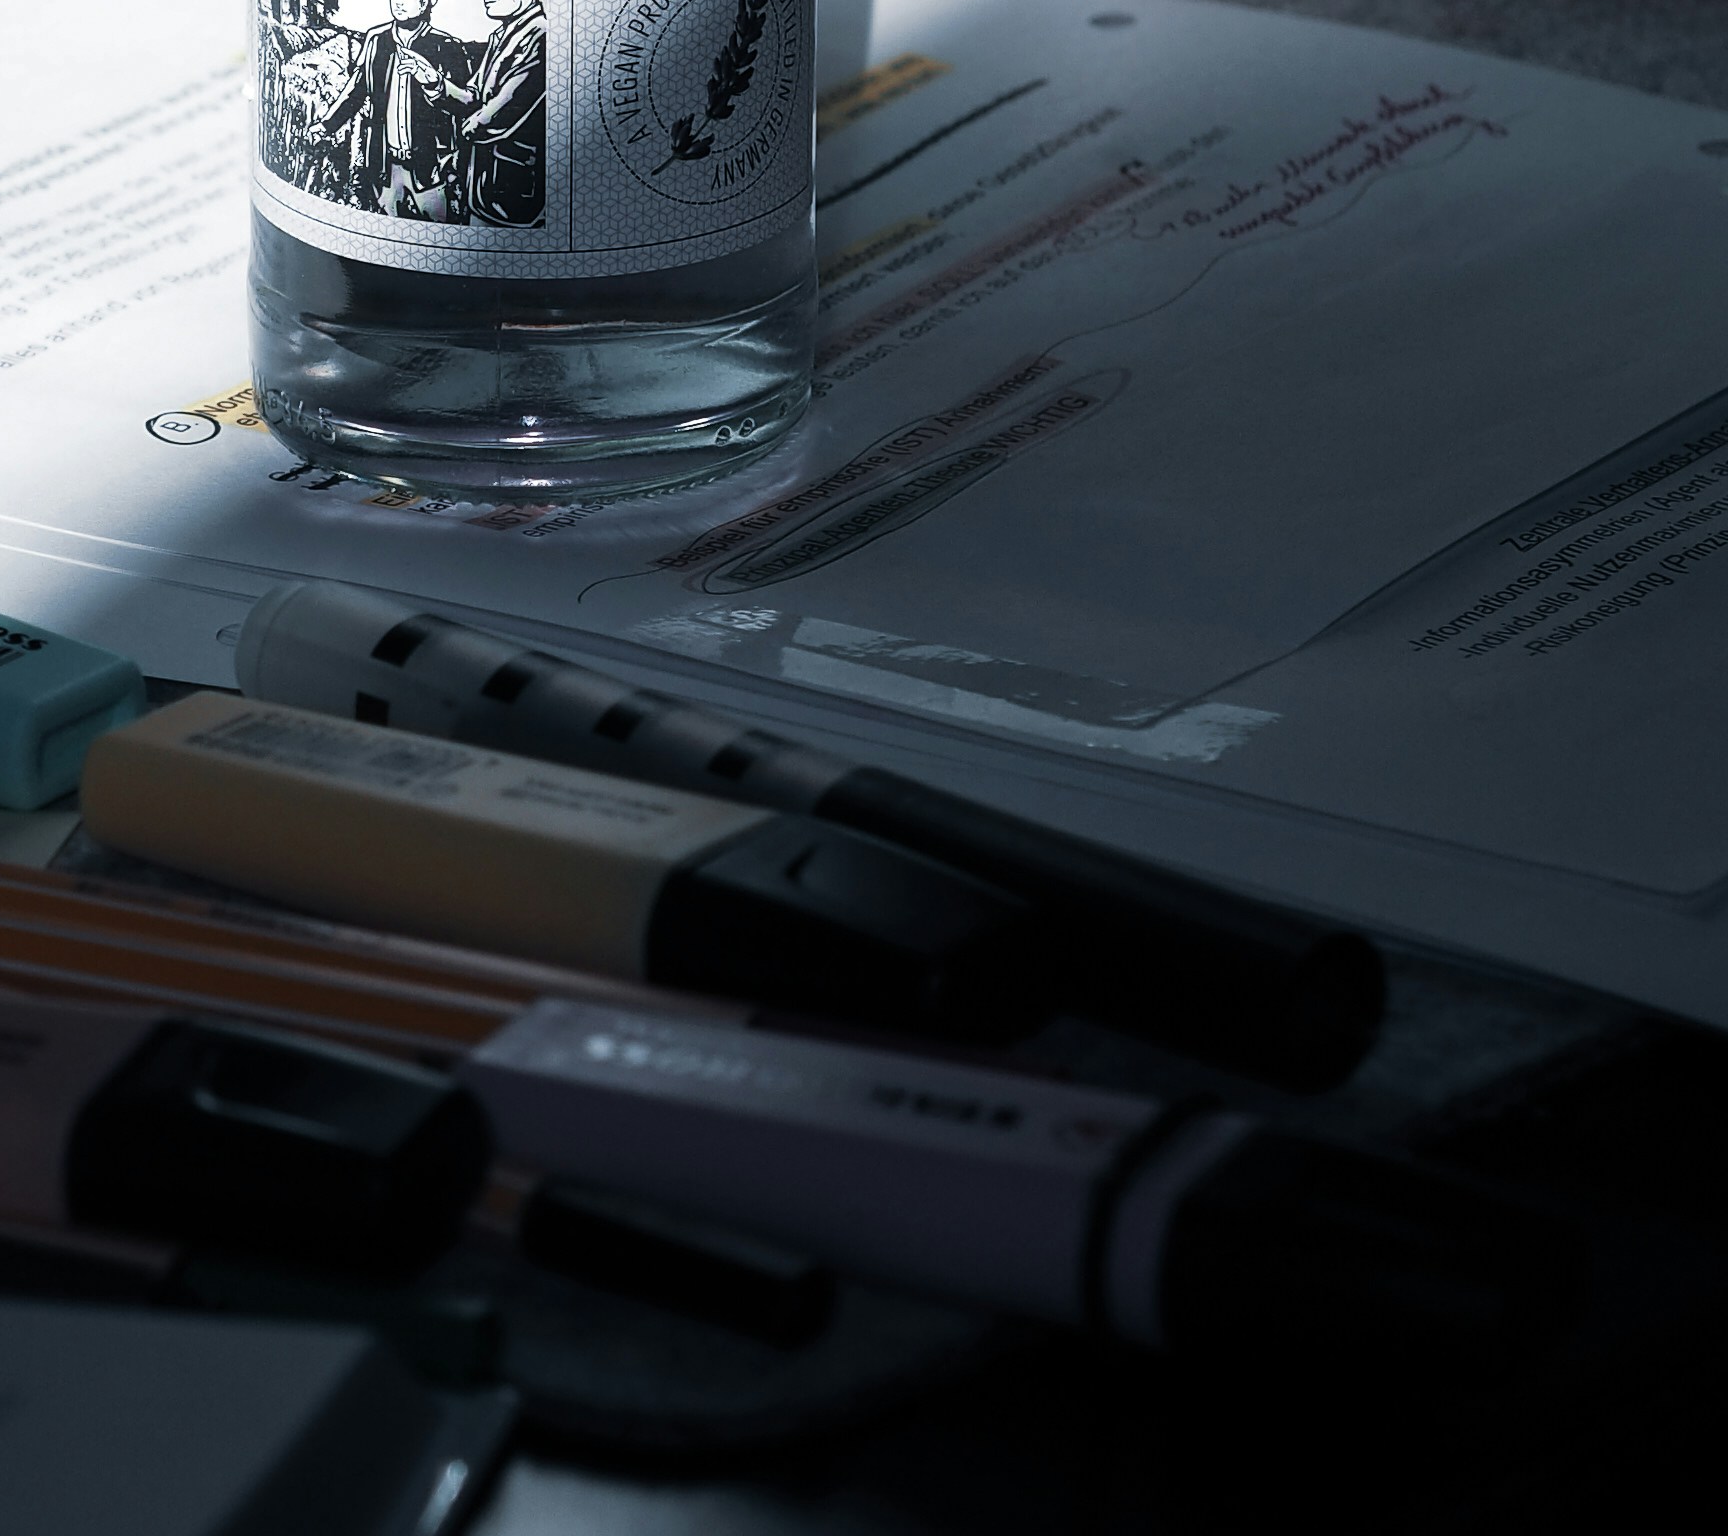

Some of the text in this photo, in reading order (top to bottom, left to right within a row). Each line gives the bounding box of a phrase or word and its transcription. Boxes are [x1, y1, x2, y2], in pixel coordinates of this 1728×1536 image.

[612, 42, 643, 126] VEGAN
[777, 77, 793, 102] IN
[627, 123, 653, 145] A
[710, 107, 783, 191] GERMANY
[983, 395, 1090, 452] WICHTIG
[656, 520, 752, 568] Beispiel
[744, 511, 783, 532] für
[1499, 504, 1592, 554] Zentrale
